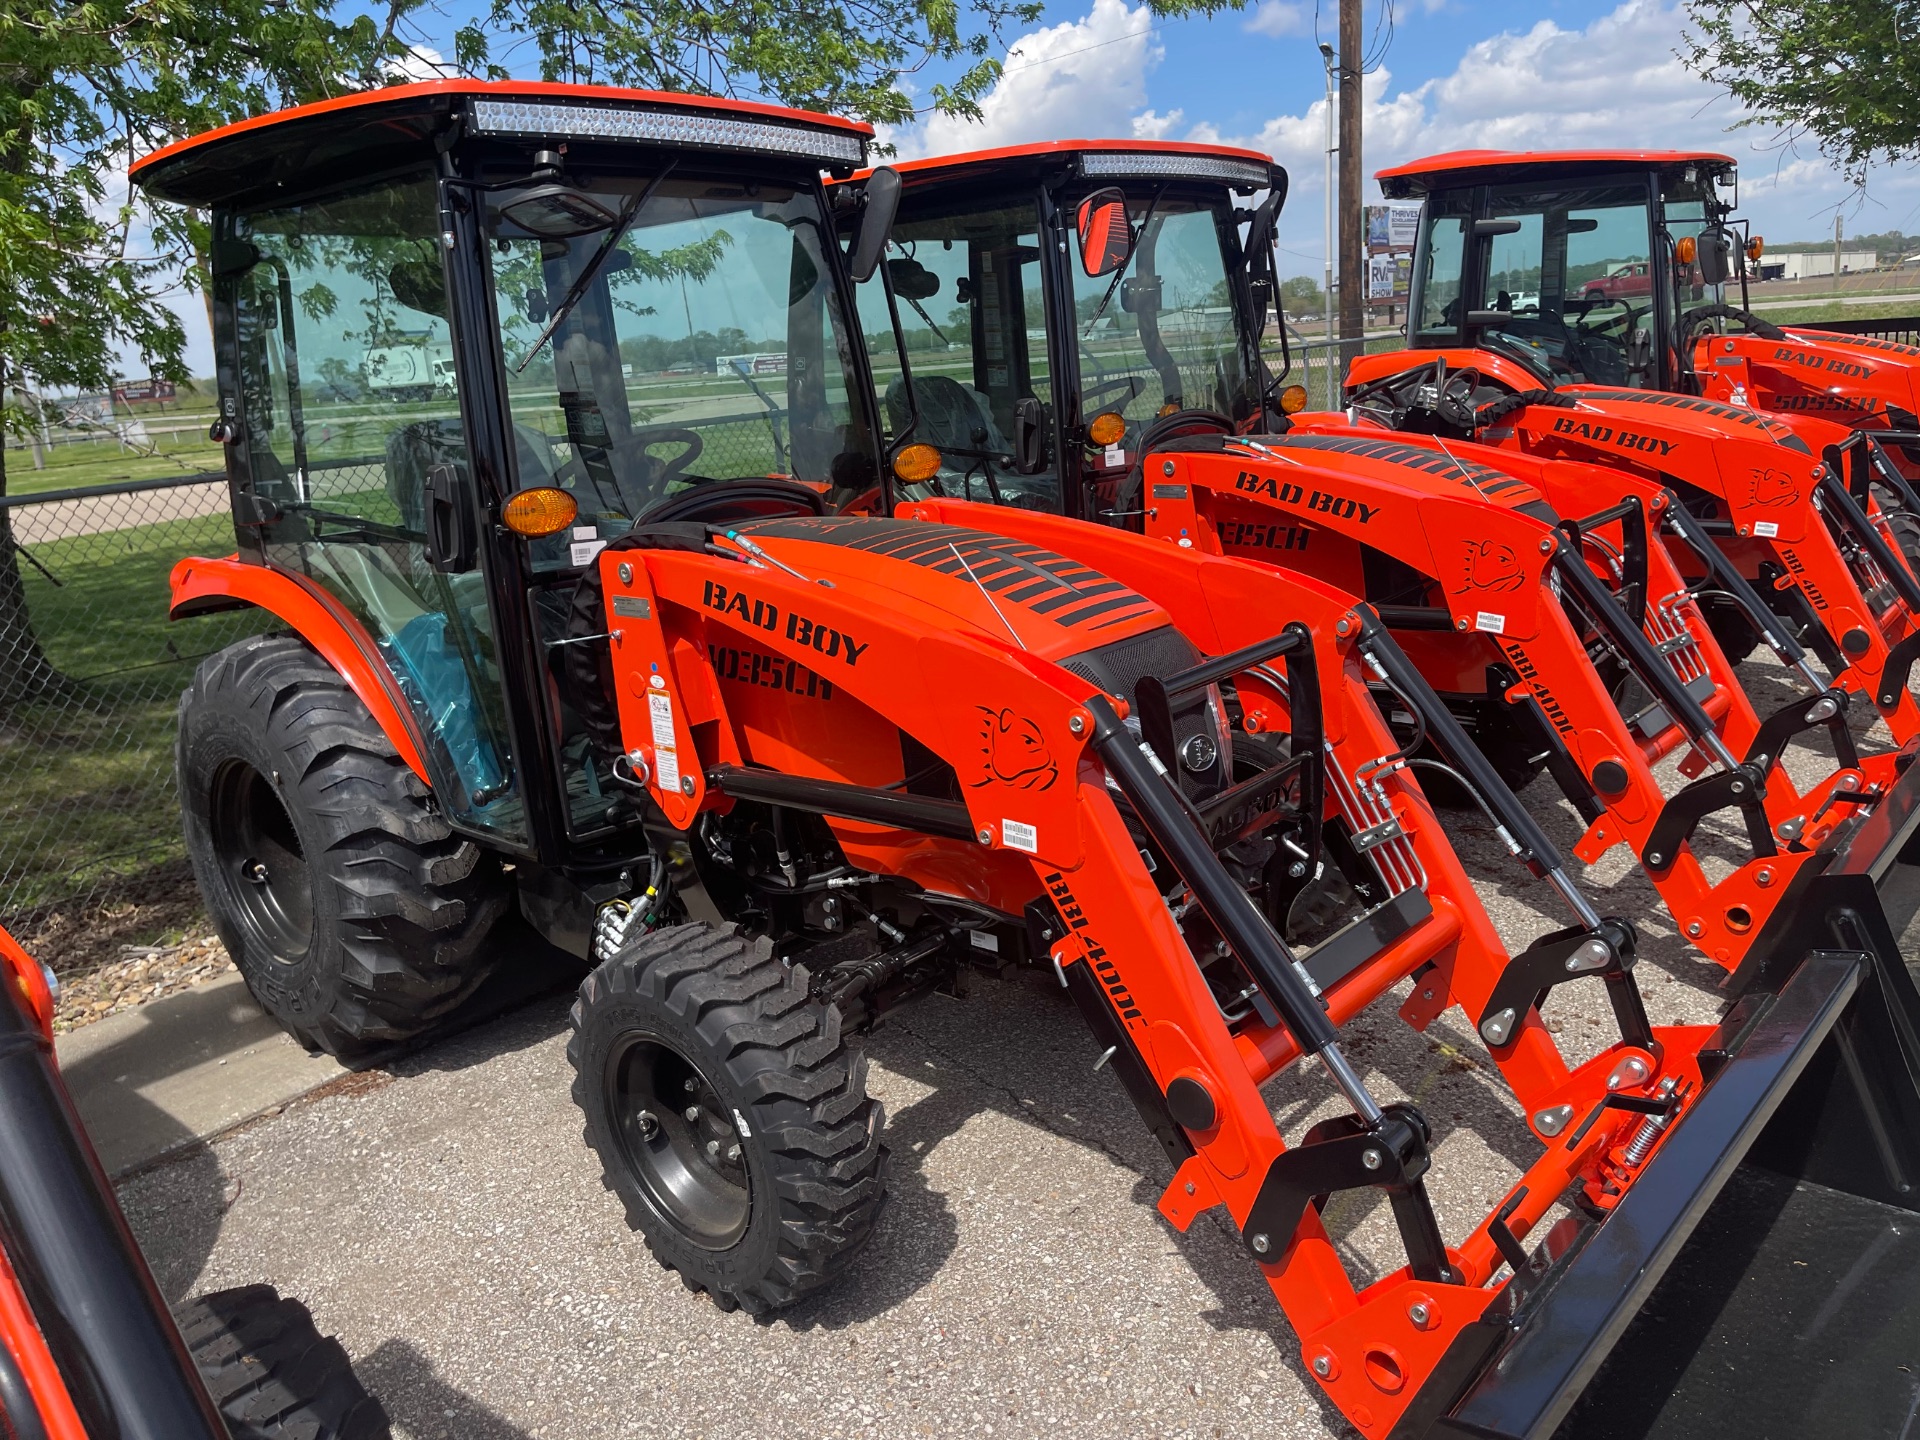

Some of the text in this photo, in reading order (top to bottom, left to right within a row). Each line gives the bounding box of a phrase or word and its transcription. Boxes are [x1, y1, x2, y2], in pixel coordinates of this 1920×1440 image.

[1372, 266, 1386, 282] RV
[1371, 289, 1393, 298] SHOW
[1774, 348, 1878, 380] BAD BOY
[1553, 418, 1680, 456] BAD BOY
[1235, 471, 1381, 524] BAD BOY
[1216, 521, 1310, 551] 35CH
[703, 580, 778, 631] BAD
[786, 612, 869, 667] BOY
